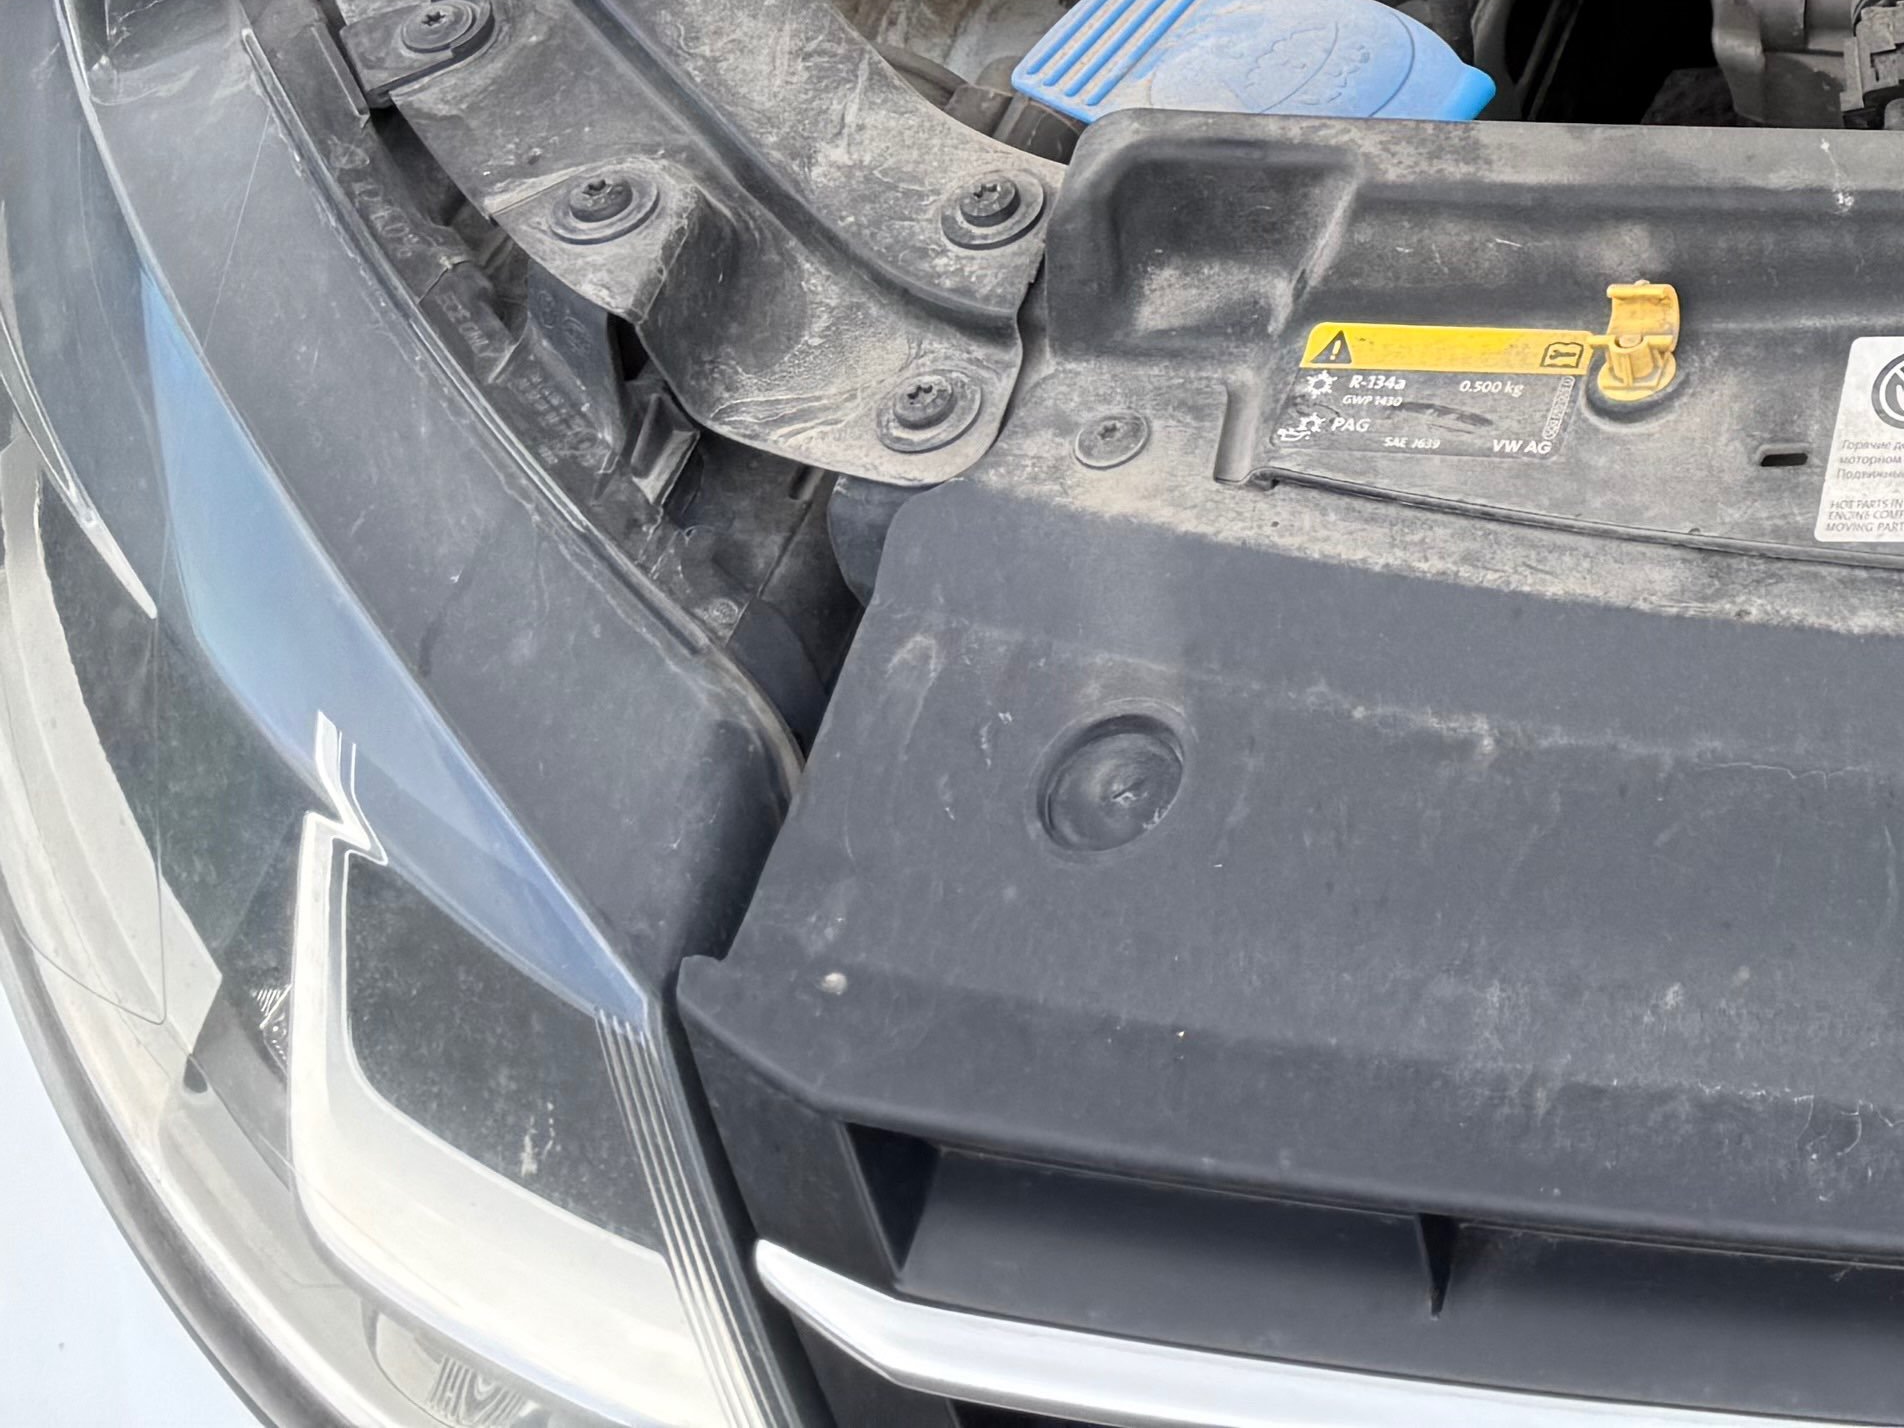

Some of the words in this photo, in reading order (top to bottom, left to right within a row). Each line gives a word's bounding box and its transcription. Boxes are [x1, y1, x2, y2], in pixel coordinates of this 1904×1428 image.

[1349, 376, 1406, 391] R-134a
[1459, 380, 1502, 393] 0.500
[1504, 381, 1524, 396] kg
[1342, 396, 1373, 406] GWP
[1331, 417, 1371, 432] PAG
[1384, 437, 1408, 448] SAE
[1492, 439, 1522, 452] VW
[1524, 440, 1551, 454] AG
[1841, 439, 1890, 451] Горячие
[1839, 455, 1901, 466] моторном
[1831, 500, 1855, 510] HOT
[1857, 499, 1889, 509] PARTS
[1891, 499, 1903, 509] IN
[1828, 511, 1869, 521] ENGINE
[1825, 522, 1873, 532] MOVING
